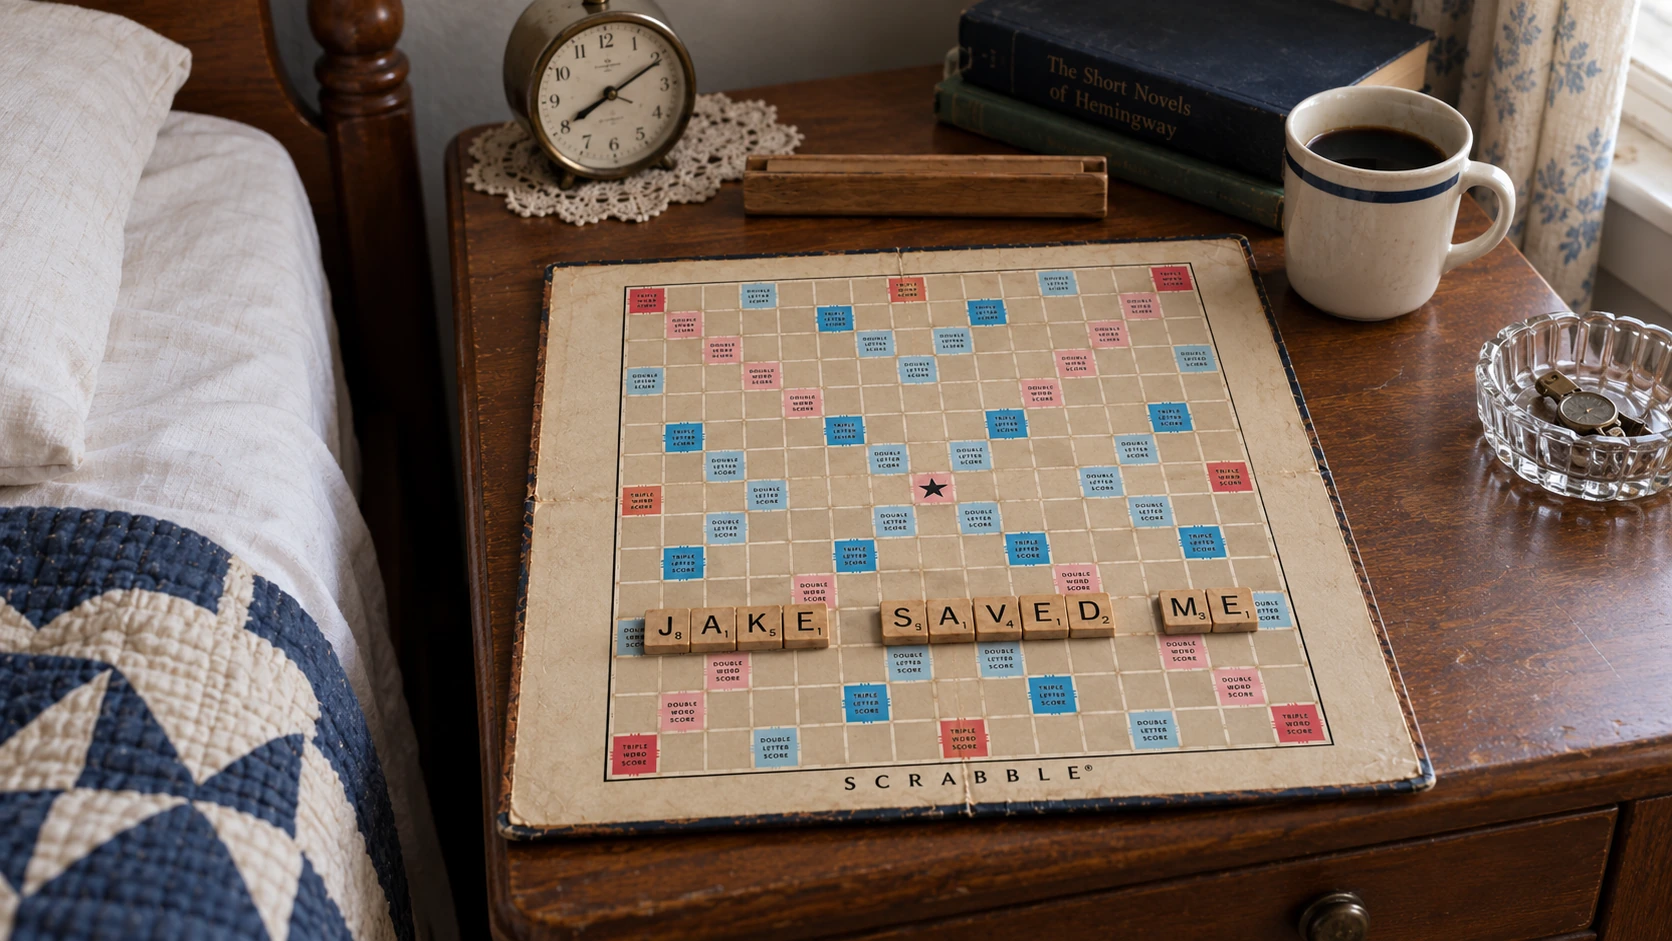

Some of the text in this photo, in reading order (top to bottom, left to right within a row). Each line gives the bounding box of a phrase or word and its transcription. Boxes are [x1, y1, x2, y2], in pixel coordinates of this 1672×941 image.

[599, 32, 614, 49] 12
[632, 36, 638, 51] 1
[574, 44, 586, 59] 11
[650, 52, 660, 66] 2
[556, 66, 570, 81] 10
[660, 76, 670, 92] 3
[1047, 54, 1191, 116] The Short Novels
[550, 94, 560, 108] 9
[652, 104, 662, 119] 4
[1050, 84, 1177, 140] of Hemingway
[560, 119, 570, 134] 8
[636, 126, 645, 140] 5
[582, 134, 592, 150] 7
[609, 136, 620, 151] 6
[658, 596, 1242, 636] JAKE SAVED ME
